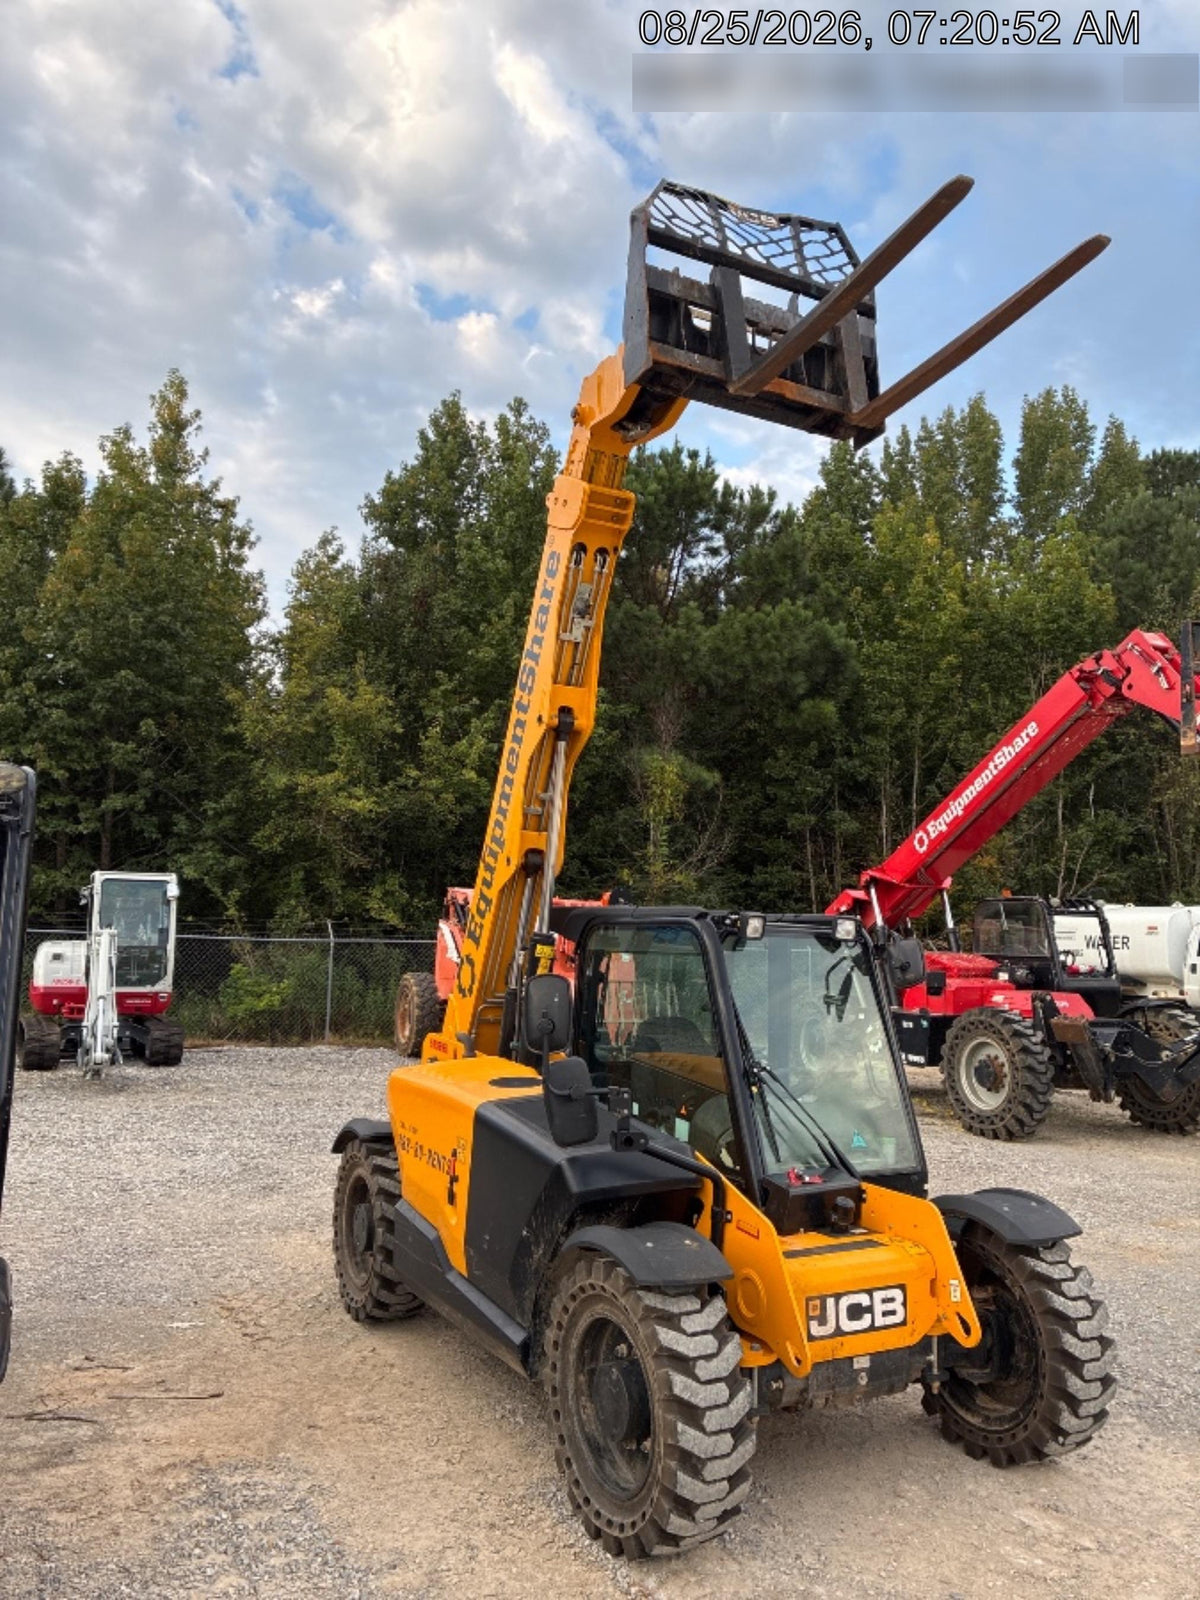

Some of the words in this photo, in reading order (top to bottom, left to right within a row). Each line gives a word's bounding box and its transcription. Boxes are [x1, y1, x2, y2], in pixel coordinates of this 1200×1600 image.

[467, 550, 560, 949] EquipmentShare
[926, 721, 1040, 839] EquipmentShare
[1084, 934, 1131, 950] WAER
[808, 1288, 906, 1336] JCB
